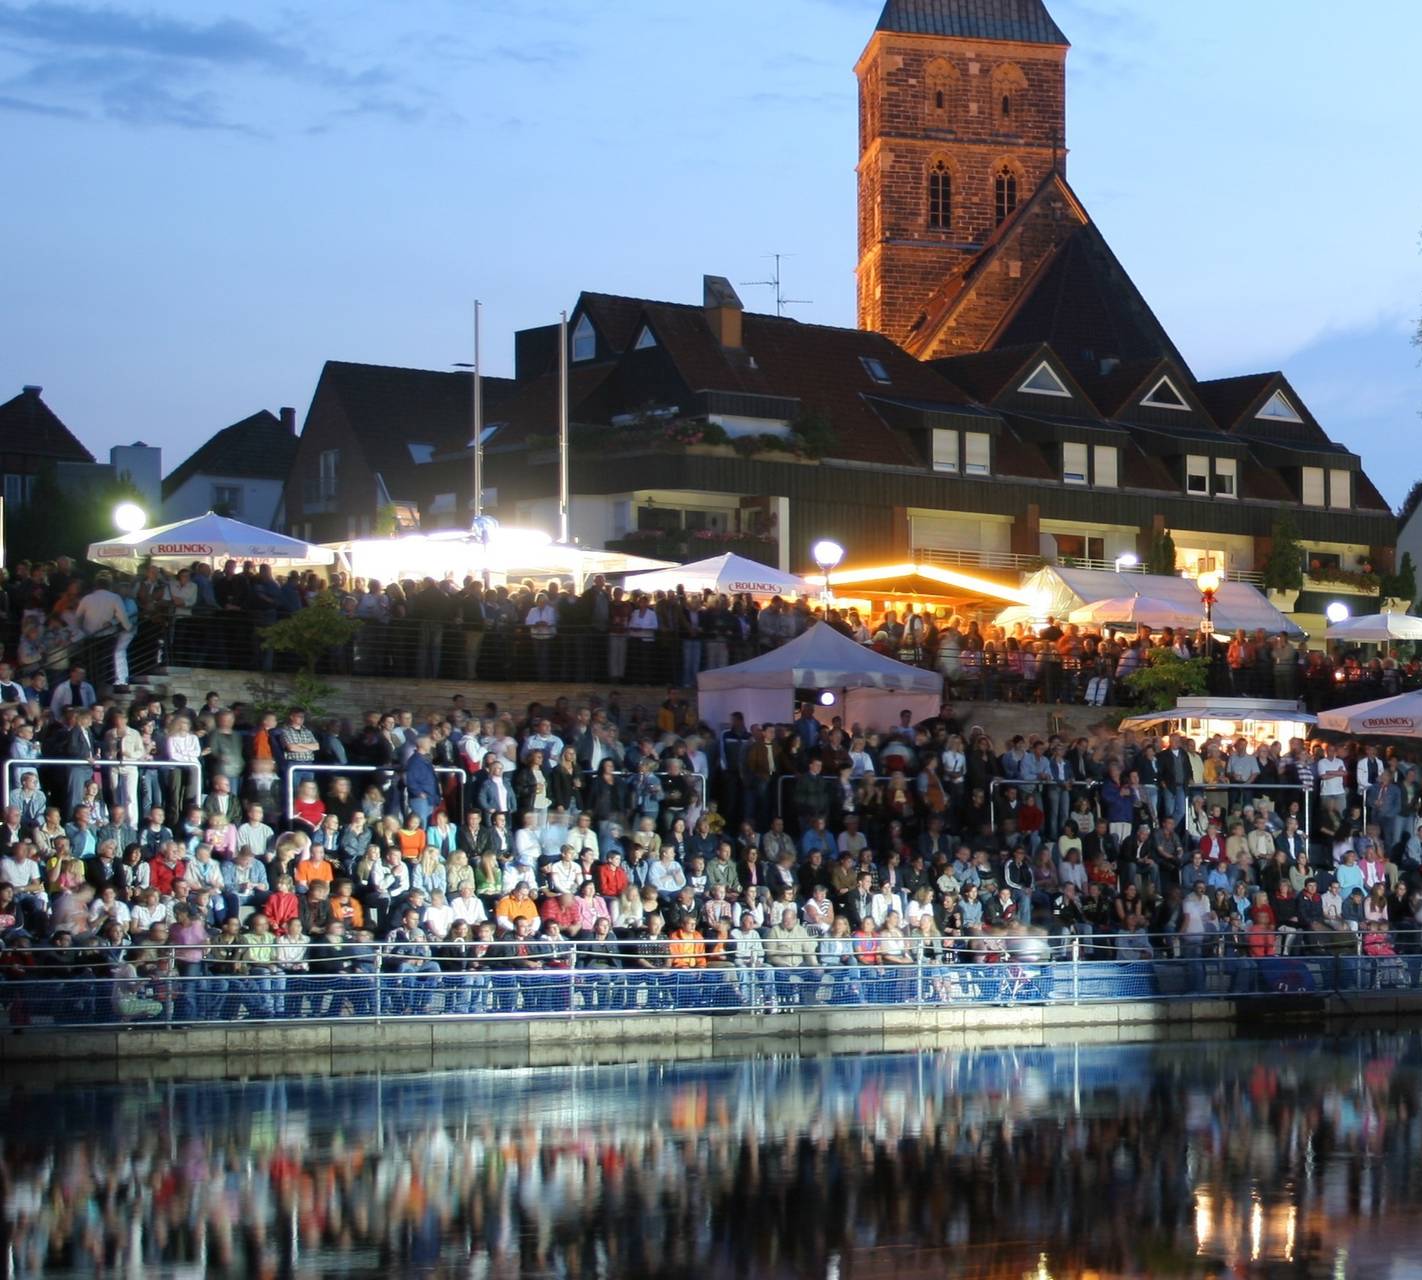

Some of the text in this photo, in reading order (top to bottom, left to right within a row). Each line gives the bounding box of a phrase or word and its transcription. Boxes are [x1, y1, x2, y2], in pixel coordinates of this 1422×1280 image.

[158, 543, 207, 553] ROLINCK
[735, 582, 776, 591] ROLINCK
[1369, 717, 1408, 726] ROLINCK
